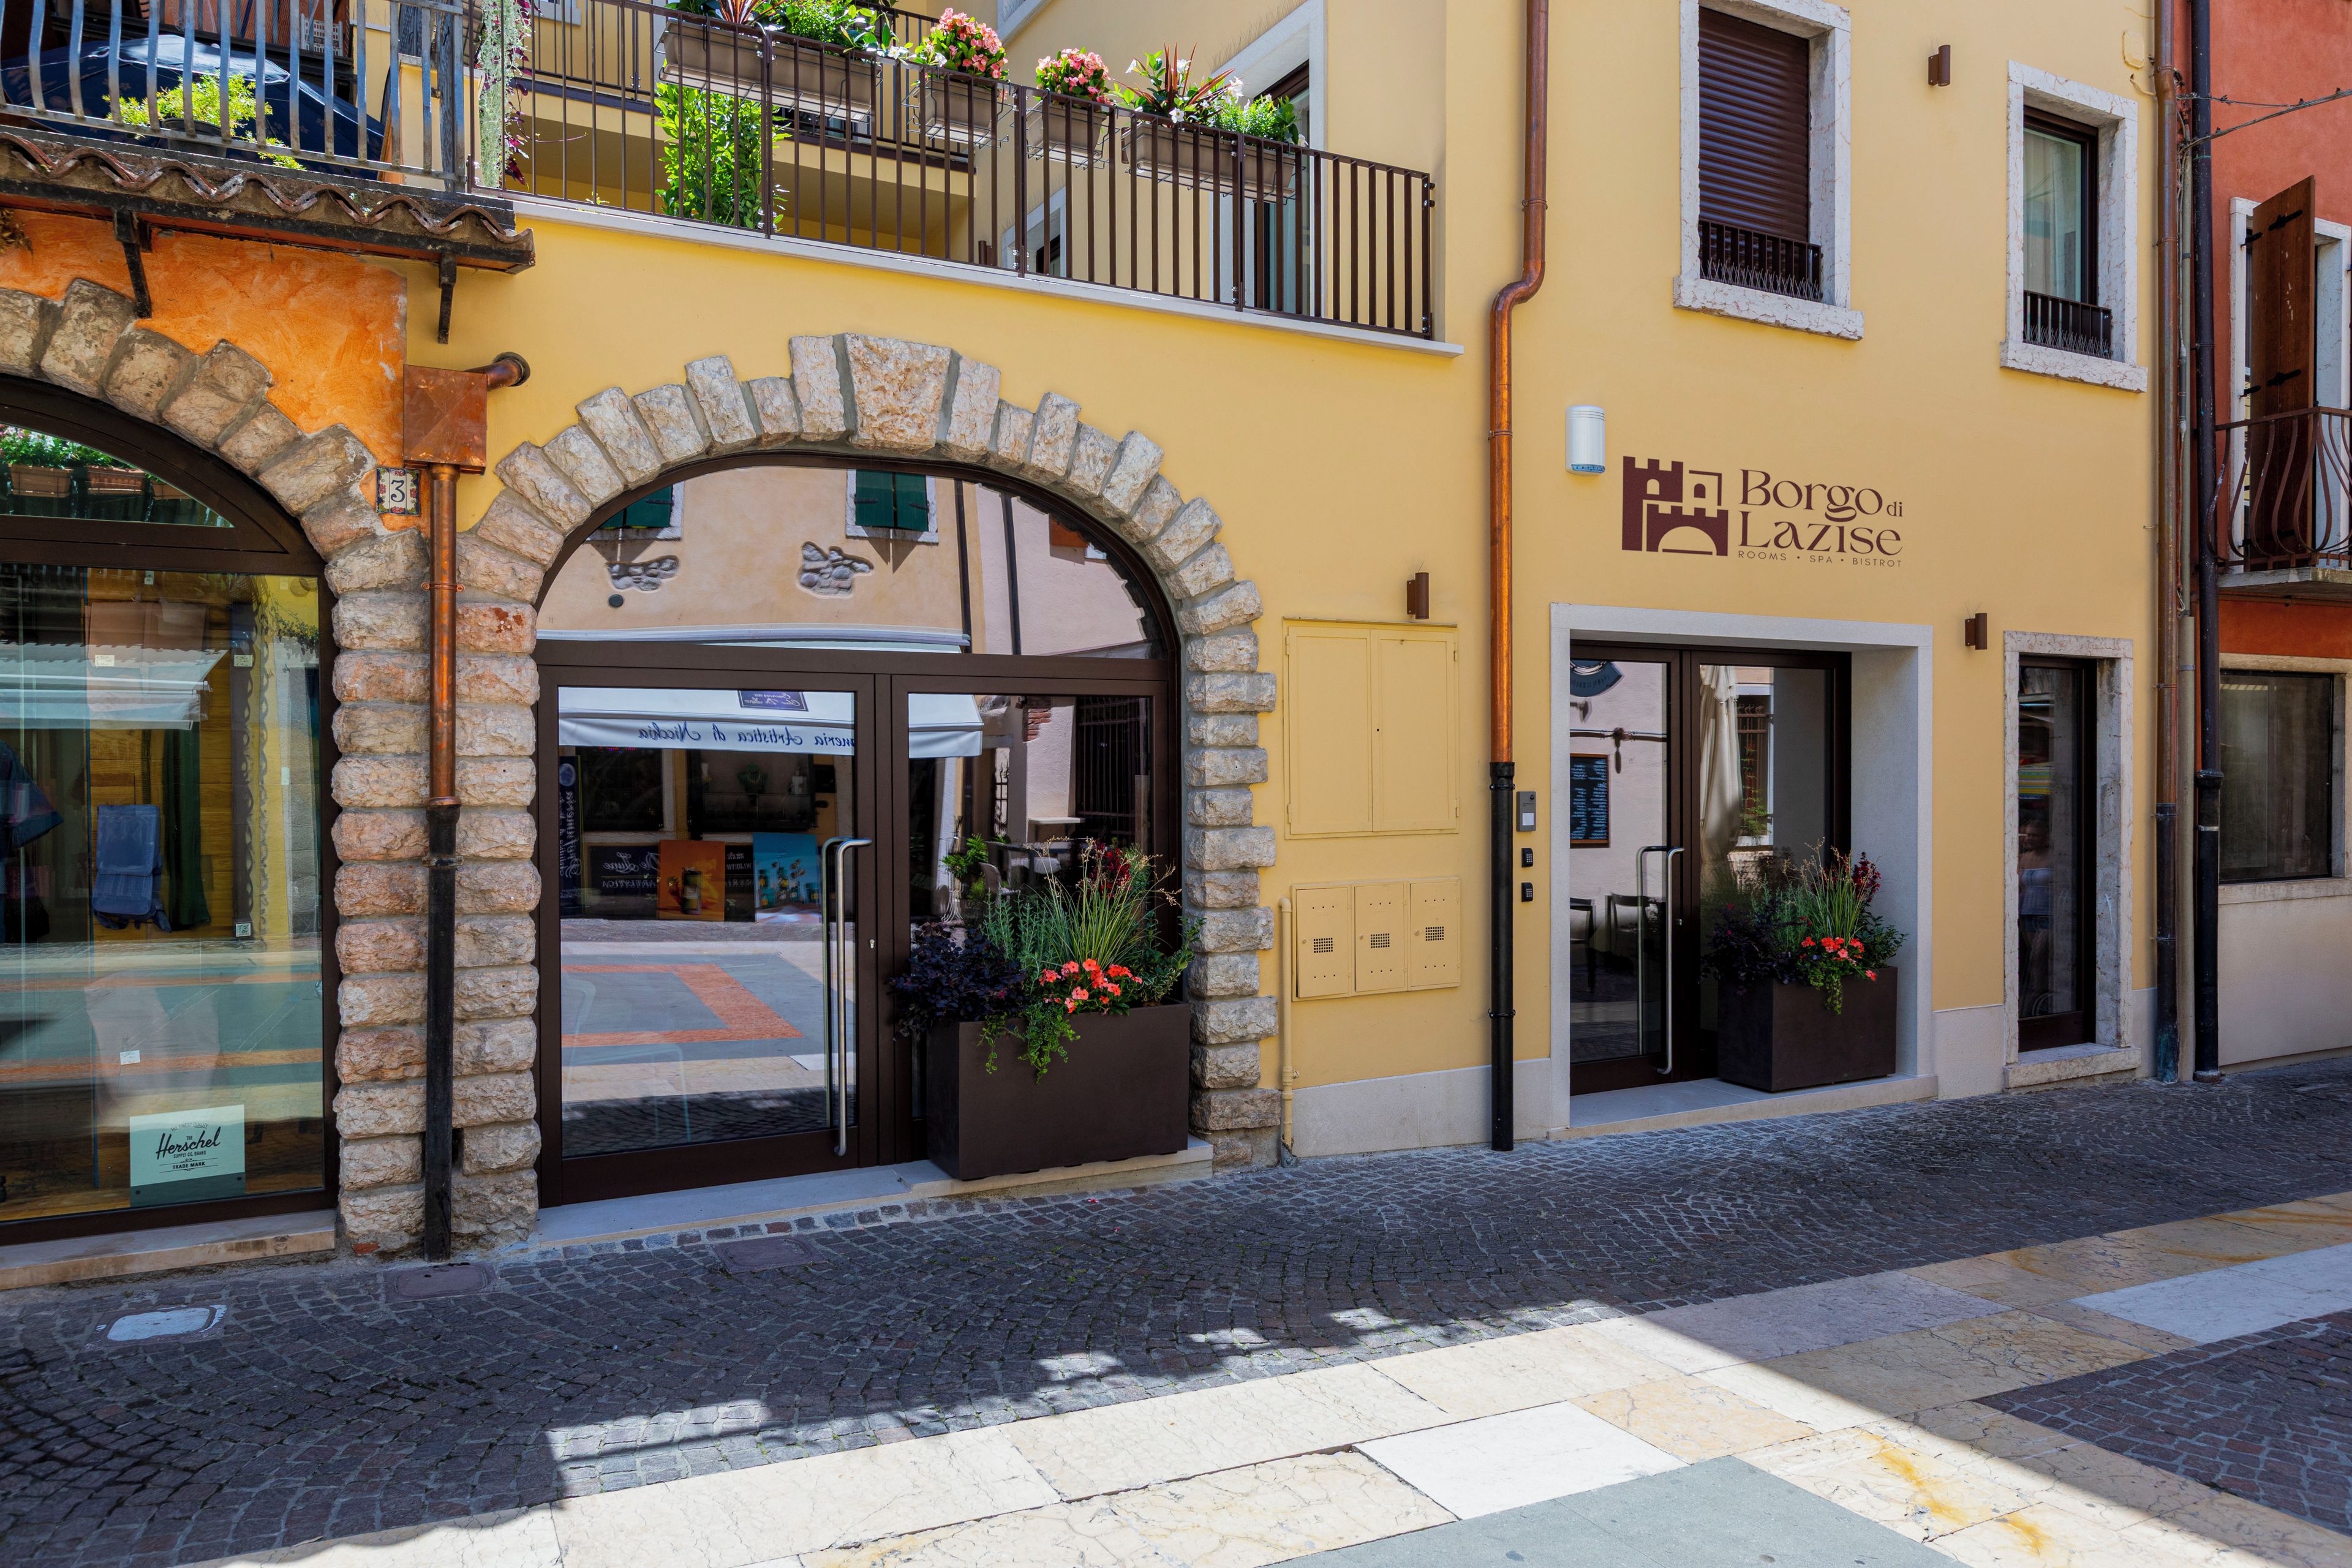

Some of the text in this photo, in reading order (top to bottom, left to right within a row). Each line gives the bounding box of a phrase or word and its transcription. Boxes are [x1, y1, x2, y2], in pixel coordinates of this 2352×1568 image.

[391, 480, 405, 502] 3
[1738, 469, 1903, 522] Borgo di
[1738, 510, 1903, 556] Lazise
[1738, 550, 1902, 568] ROOMS SPA BISTROT
[156, 1126, 221, 1160] Herschel
